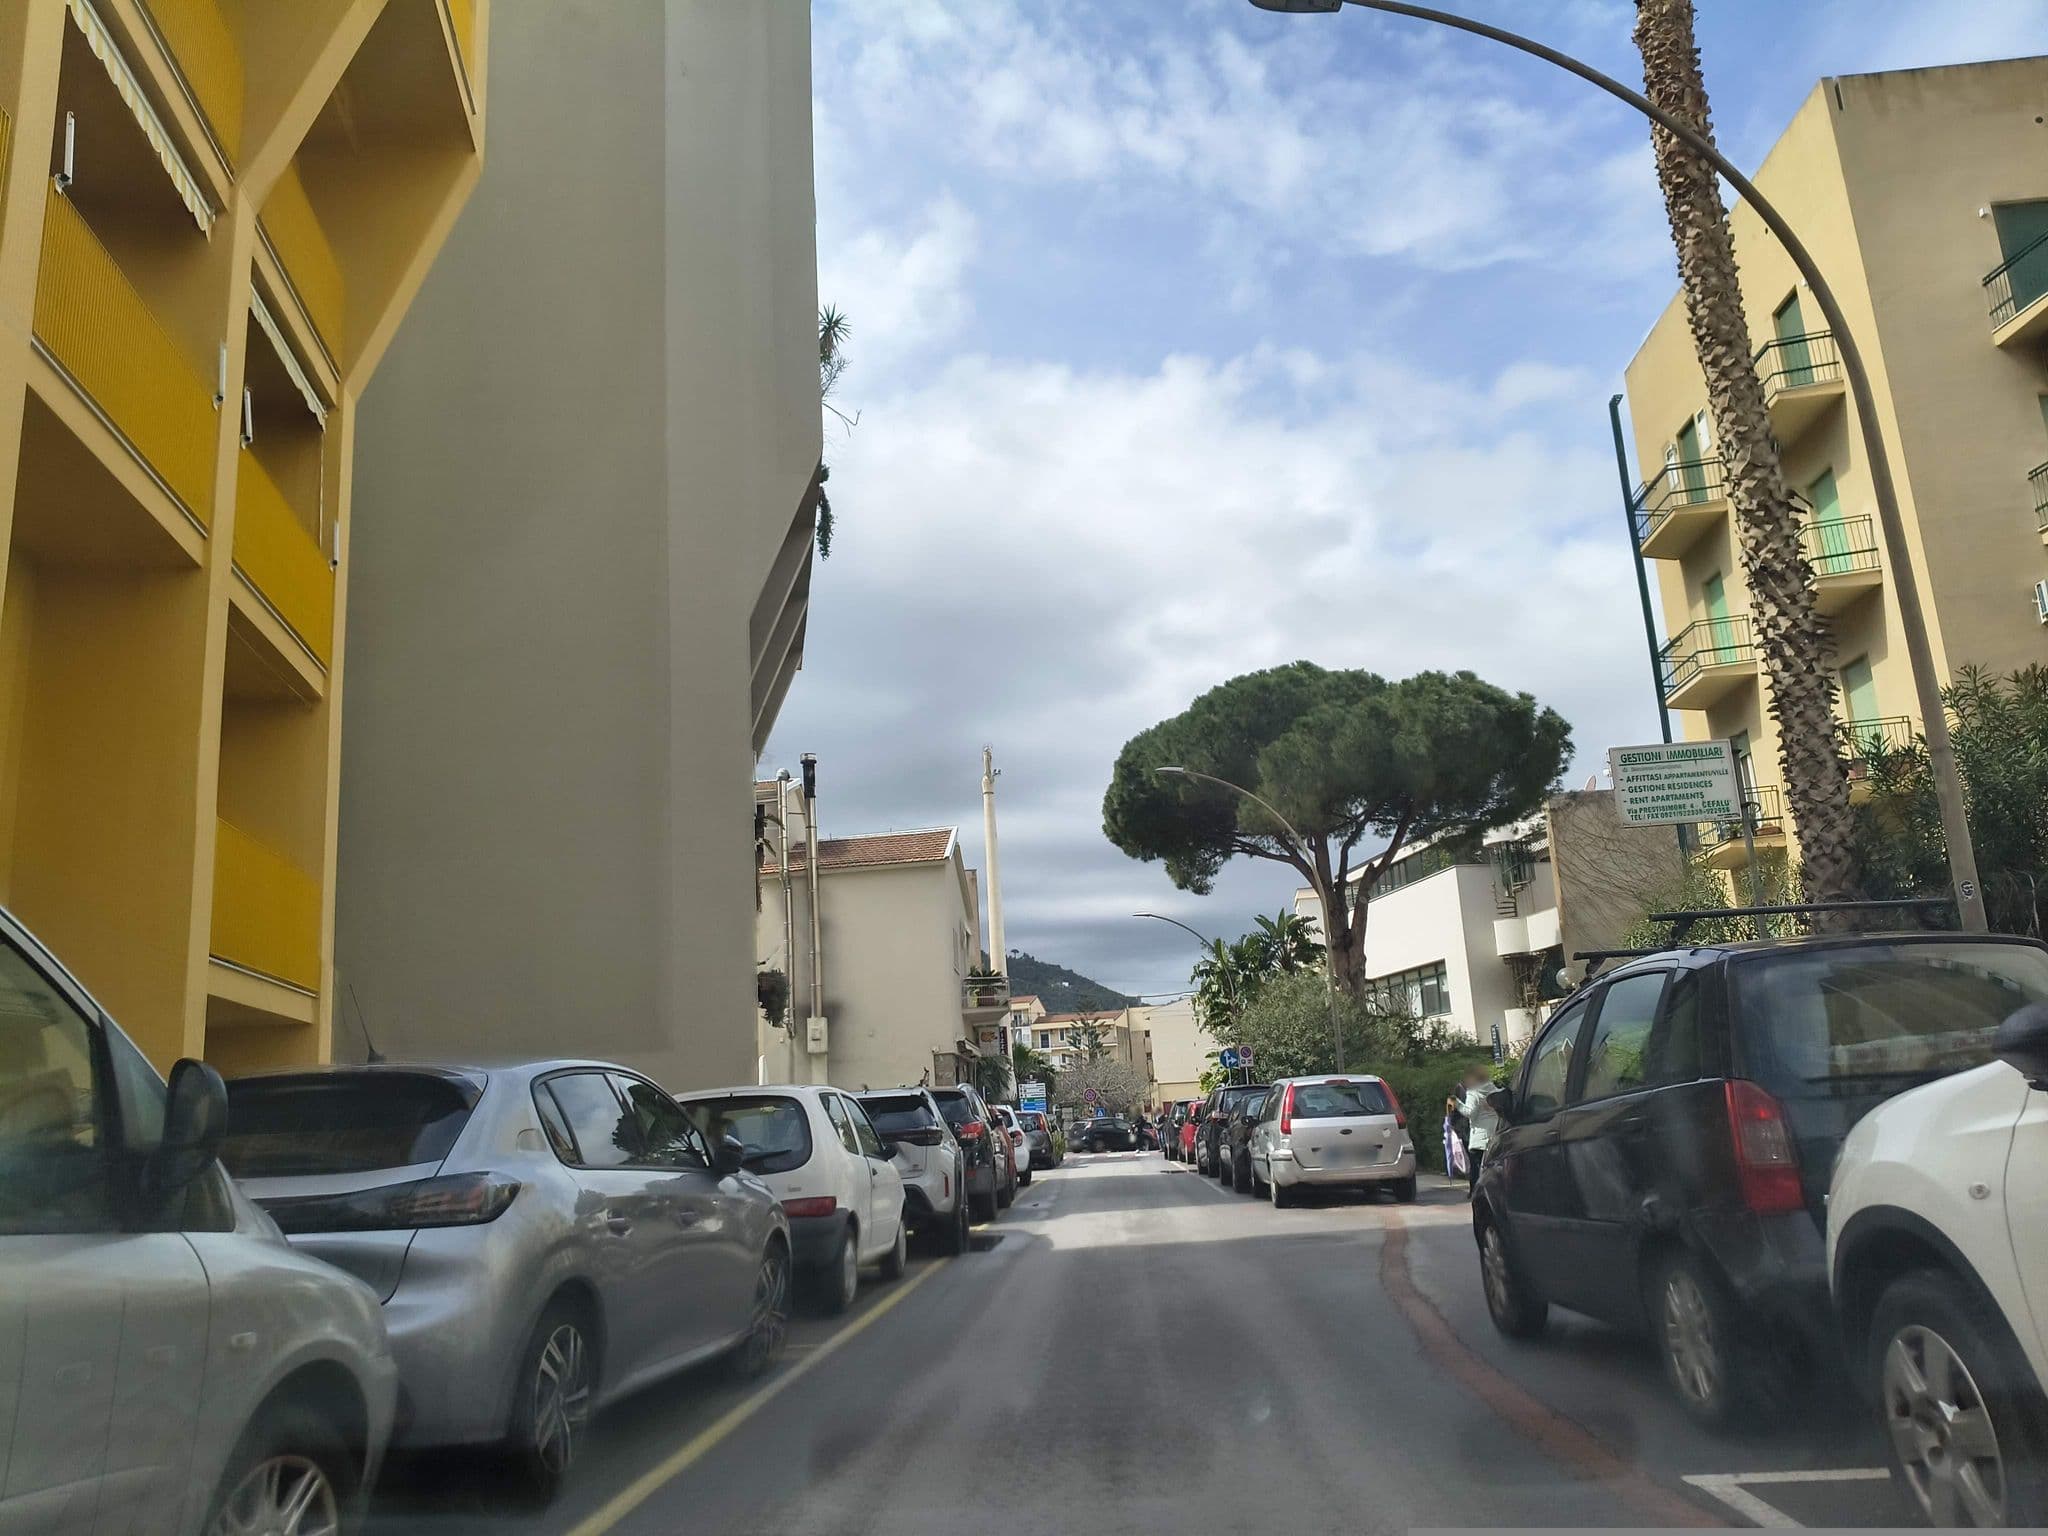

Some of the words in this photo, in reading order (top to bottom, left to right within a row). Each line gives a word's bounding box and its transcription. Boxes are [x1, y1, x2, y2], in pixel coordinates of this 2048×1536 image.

[1620, 751, 1661, 763] GESTIONI
[1666, 747, 1722, 760] IMMOBILIARI
[1626, 773, 1662, 783] AFFITTASI
[1628, 783, 1666, 793] GESTIONE
[1668, 780, 1713, 790] RESIDENCES
[1630, 796, 1649, 804] RENT
[1651, 792, 1704, 802] APARTAMENTS
